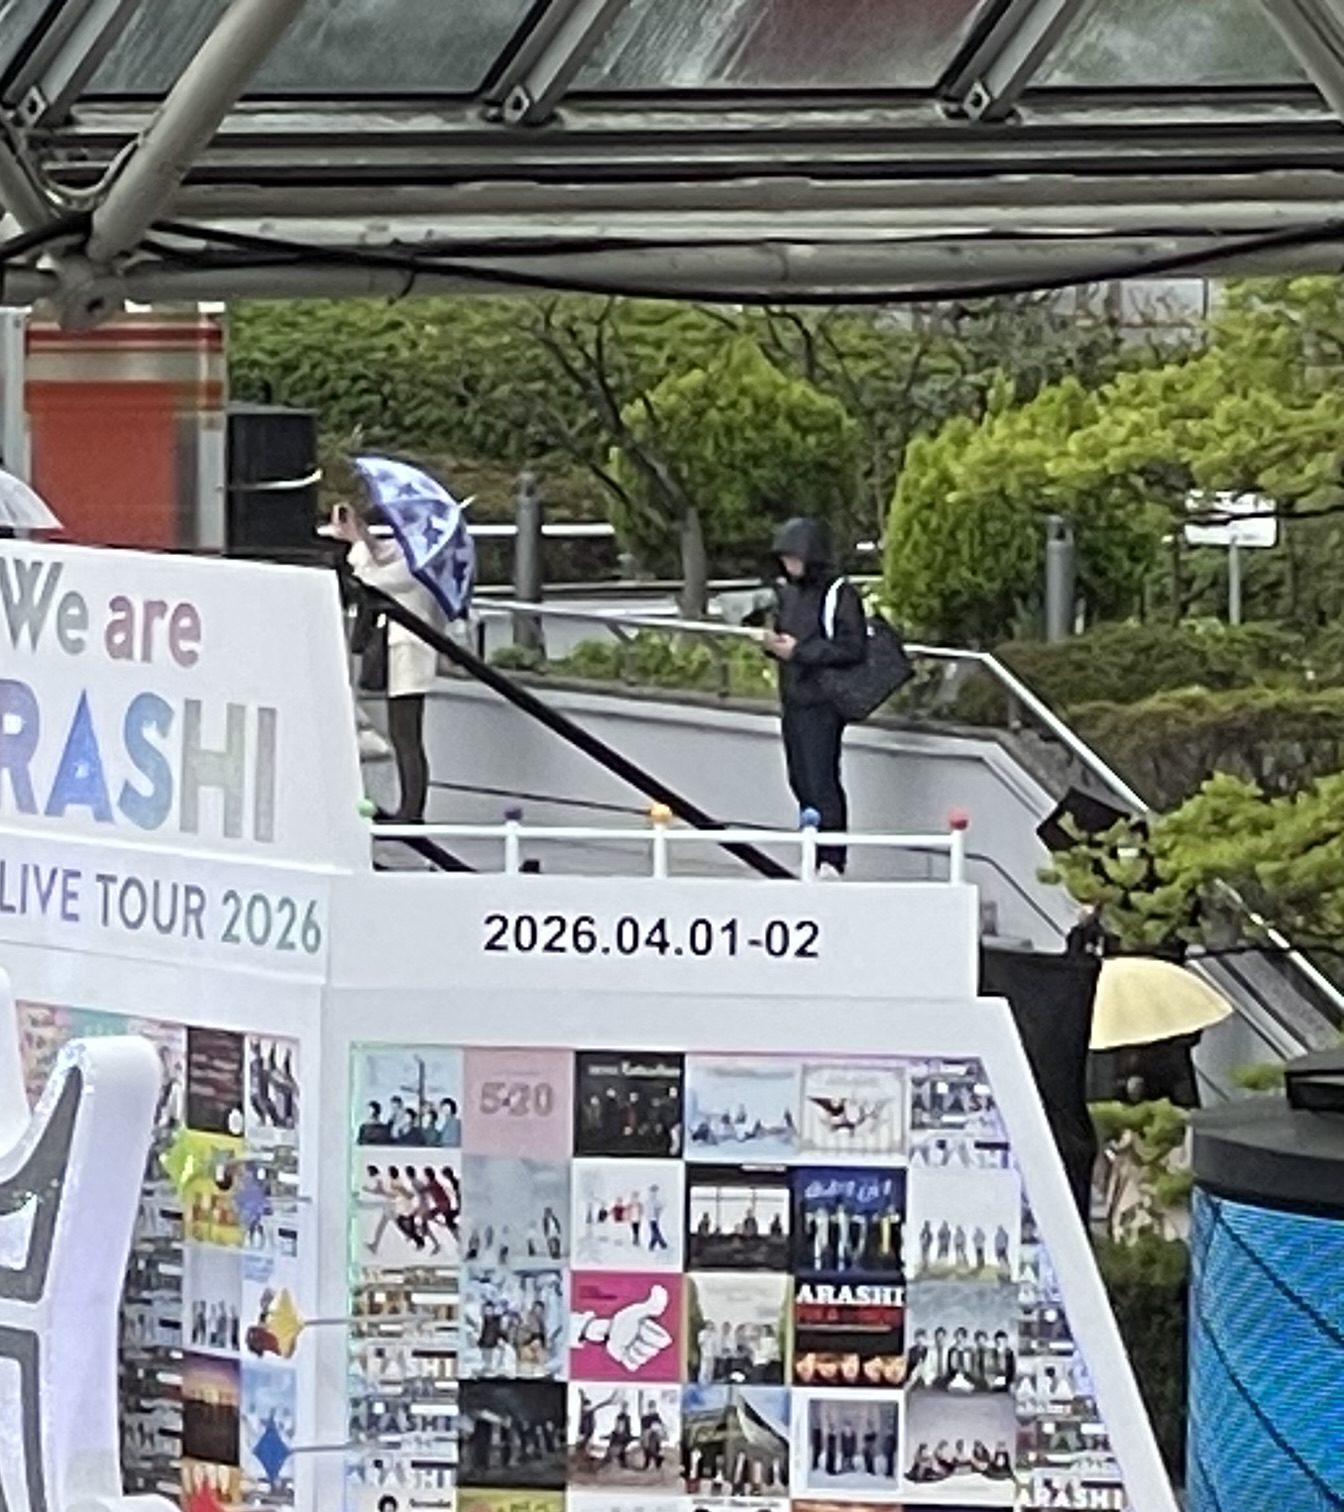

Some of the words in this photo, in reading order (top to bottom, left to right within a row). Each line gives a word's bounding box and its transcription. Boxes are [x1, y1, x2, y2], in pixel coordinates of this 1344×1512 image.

[104, 594, 202, 668] are
[96, 872, 207, 941] TOUR
[221, 889, 322, 955] 2026
[483, 913, 821, 959] 2026.04.01-02
[796, 1284, 904, 1306] ARASHI
